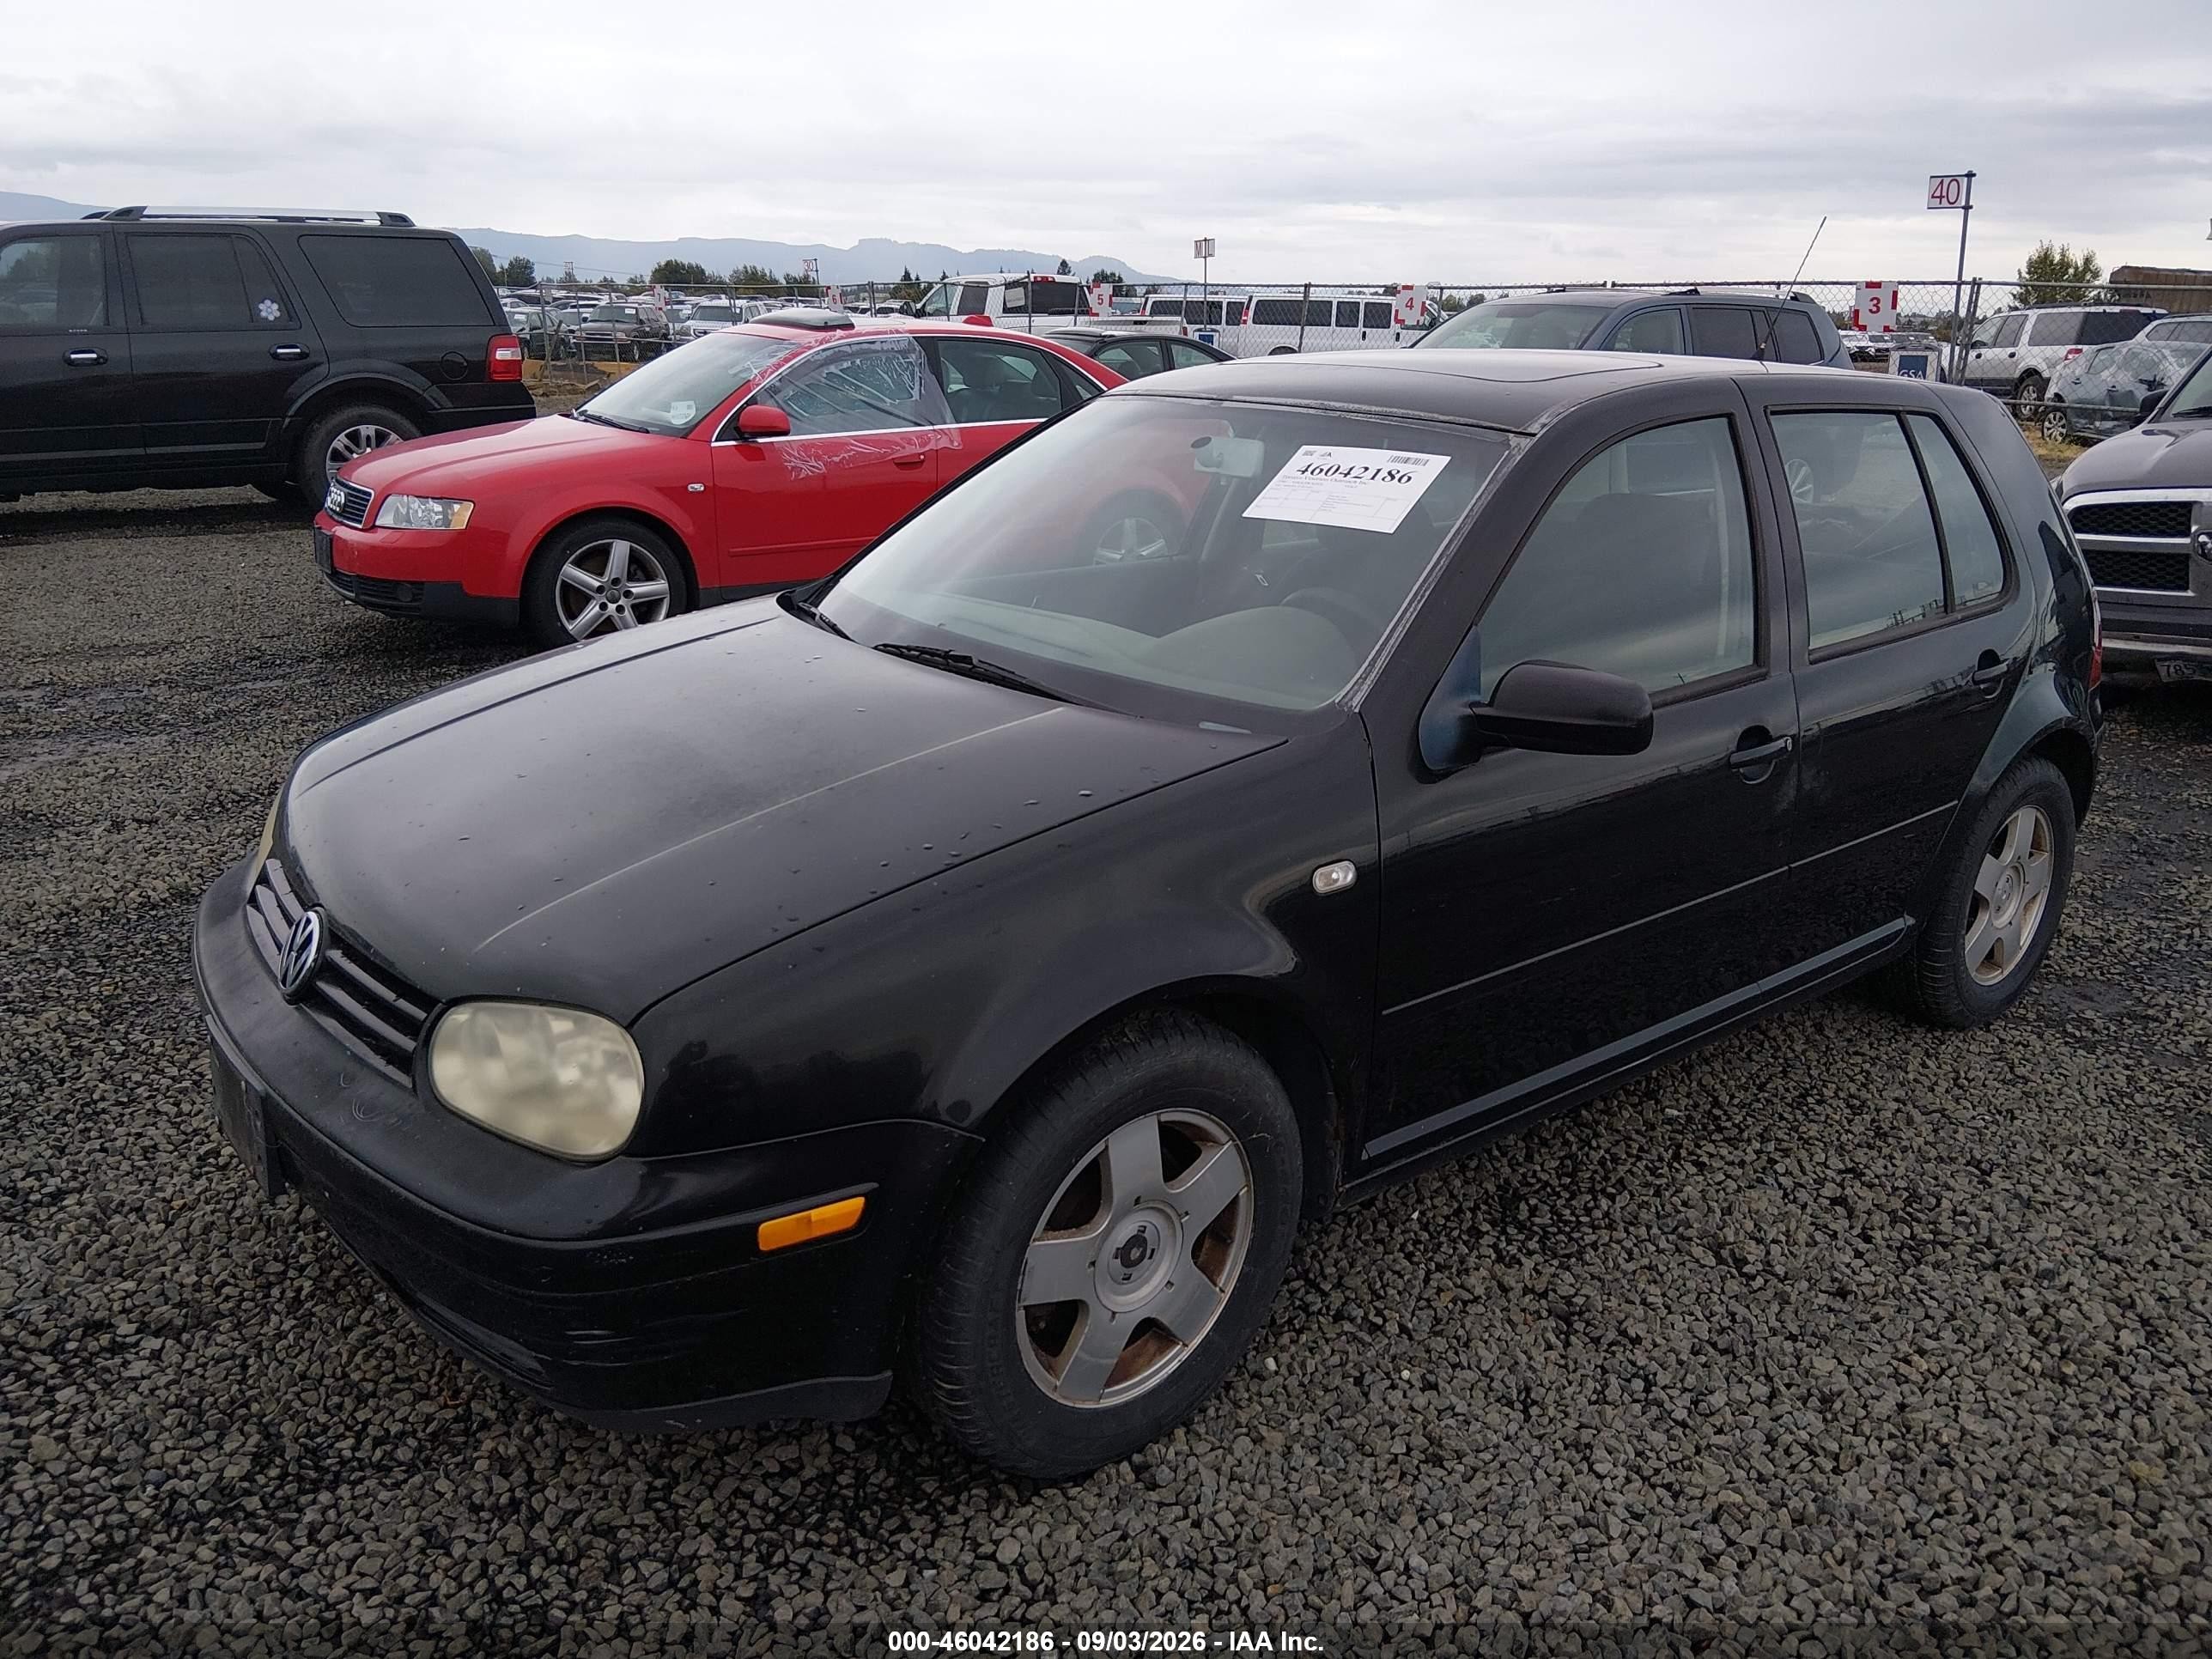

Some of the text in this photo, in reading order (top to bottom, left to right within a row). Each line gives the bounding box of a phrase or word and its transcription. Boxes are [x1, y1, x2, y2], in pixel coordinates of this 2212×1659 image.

[1930, 179, 1960, 205] 40
[831, 295, 837, 305] 6
[1097, 294, 1104, 305] 5
[1405, 297, 1415, 311] 4
[1868, 296, 1881, 314] 3
[1899, 369, 1924, 380] GSA
[1297, 462, 1417, 484] 46042186
